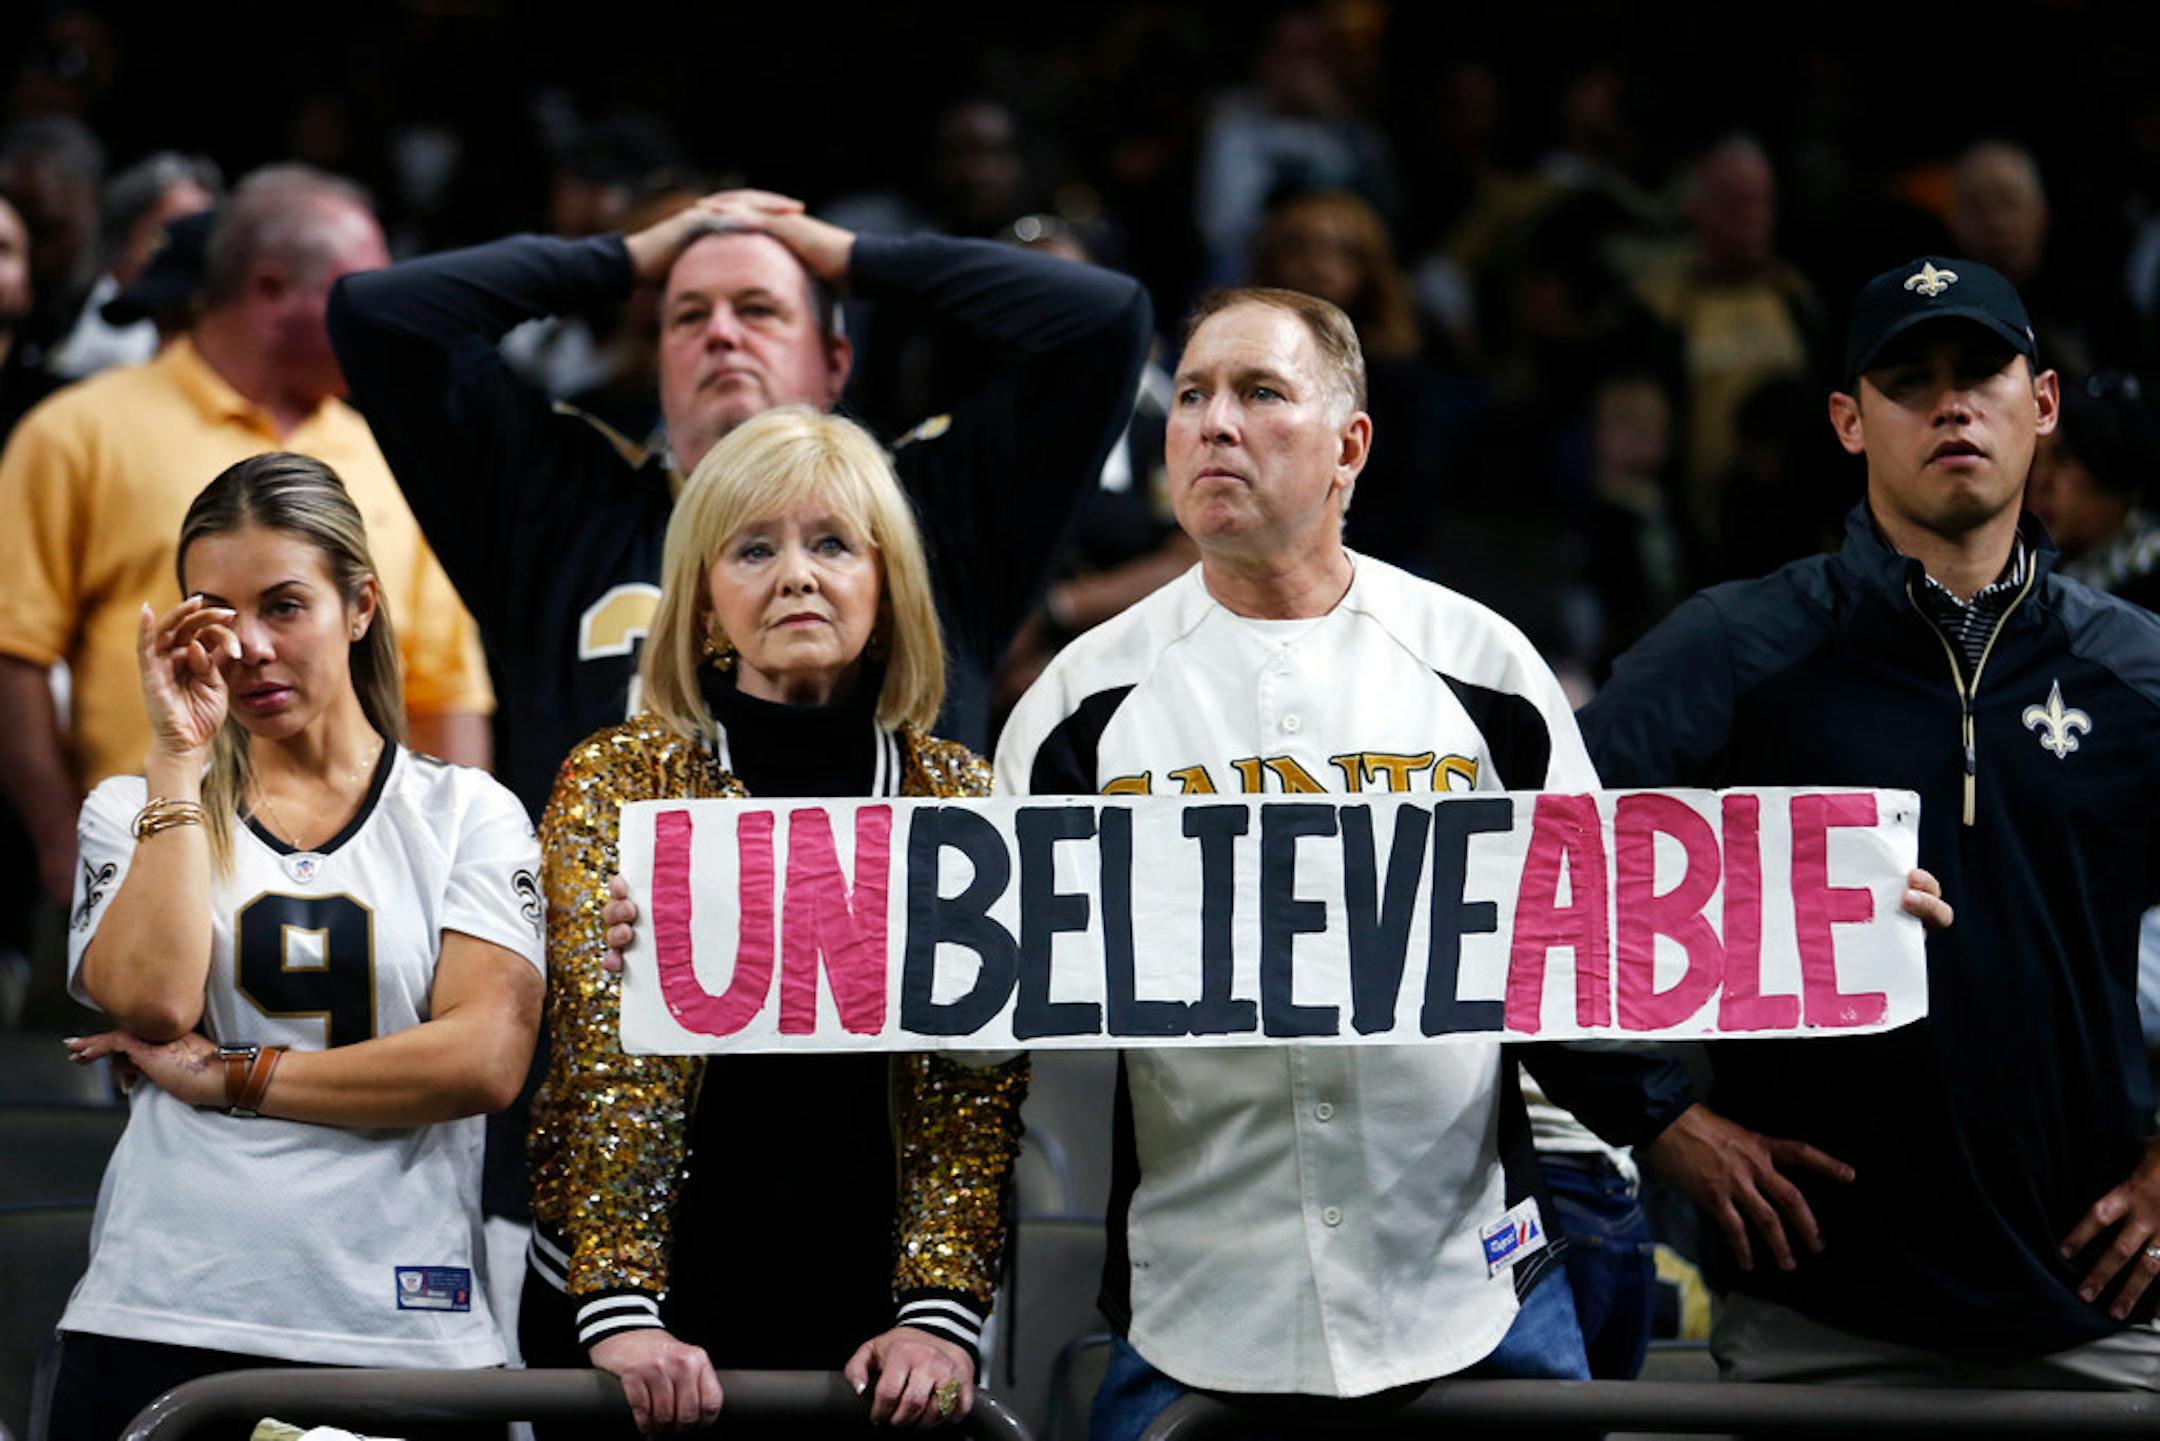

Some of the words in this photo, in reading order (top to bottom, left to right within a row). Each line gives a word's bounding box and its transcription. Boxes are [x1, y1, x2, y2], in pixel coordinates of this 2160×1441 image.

[1100, 751, 1479, 793] INTS
[234, 890, 377, 1048] 9
[652, 793, 1887, 1037] UNBELIEVEABLE
